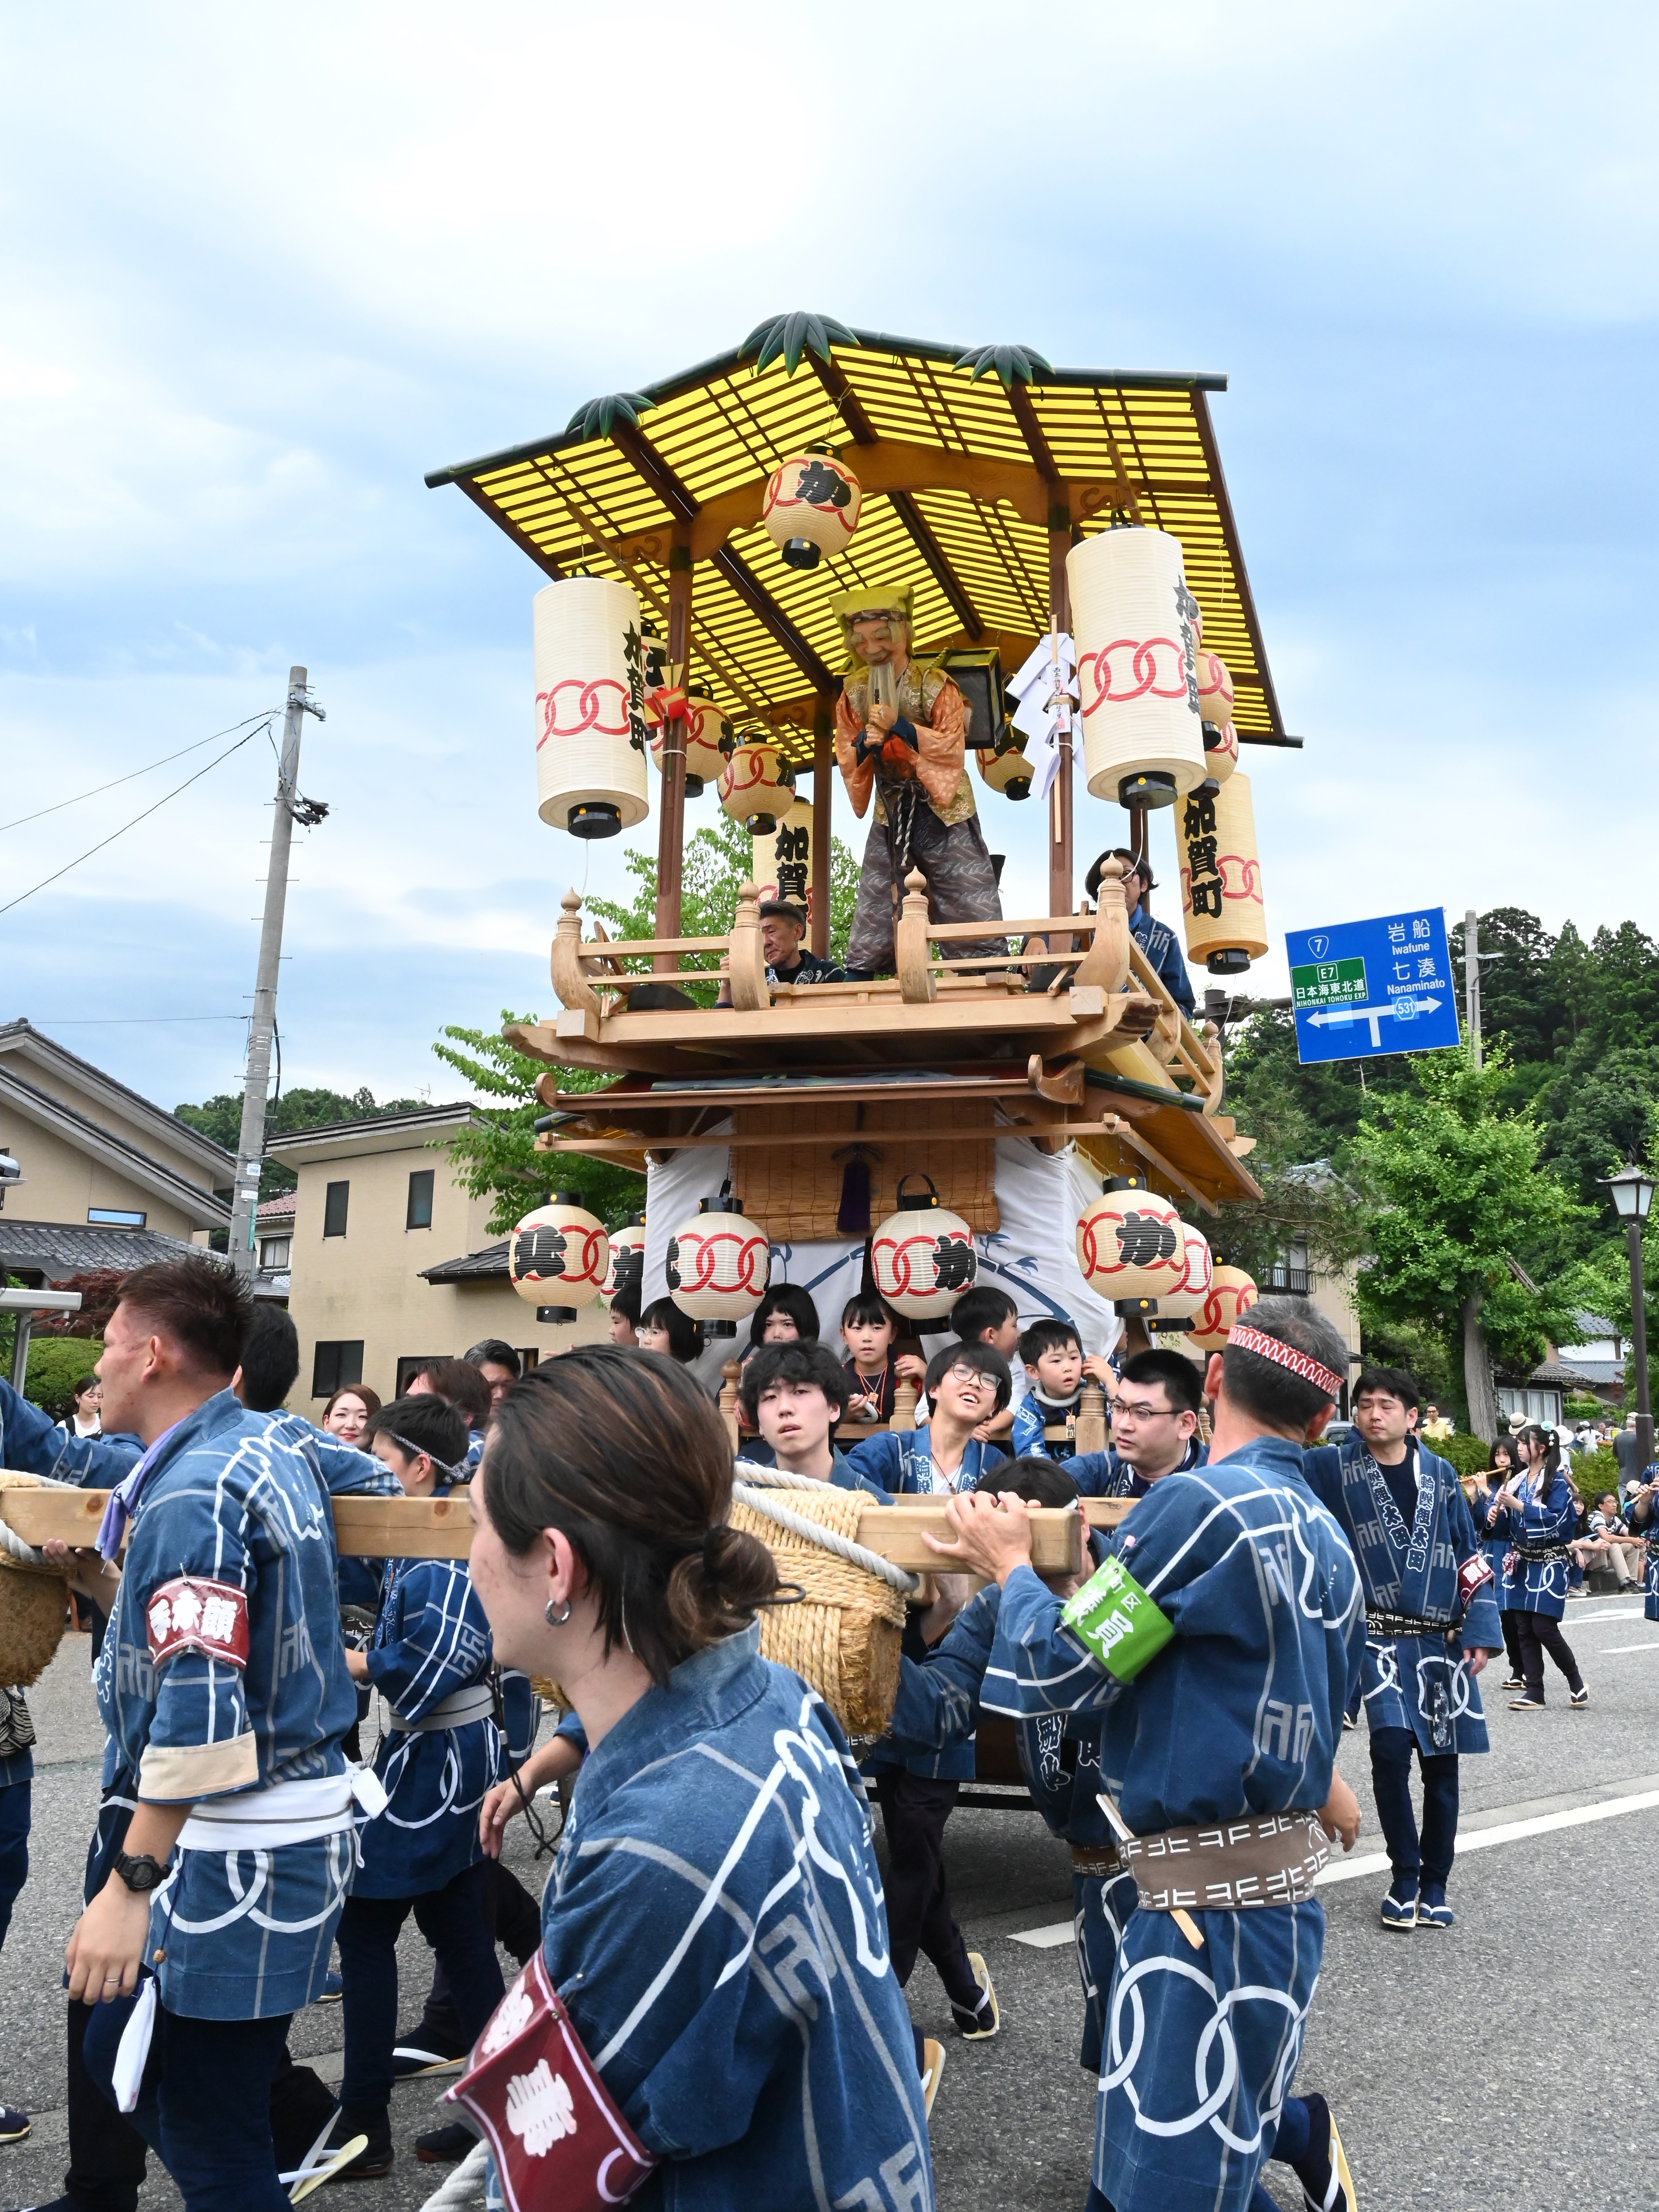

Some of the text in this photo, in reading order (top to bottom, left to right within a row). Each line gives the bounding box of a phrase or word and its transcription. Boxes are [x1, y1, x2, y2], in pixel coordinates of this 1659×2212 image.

[1184, 797, 1223, 918] 加賀町
[1388, 919, 1431, 943] 岩船
[1314, 939, 1322, 952] 7
[1392, 942, 1430, 955] Iwafune
[1321, 966, 1334, 979] E7
[1392, 957, 1436, 981] 七湊
[1296, 979, 1365, 999] 日本海東北道
[1387, 979, 1445, 995] Nanaminato
[1296, 997, 1326, 1007] NIHONKAI
[1328, 995, 1352, 1003] TOHOKU
[1397, 1003, 1413, 1014] 531
